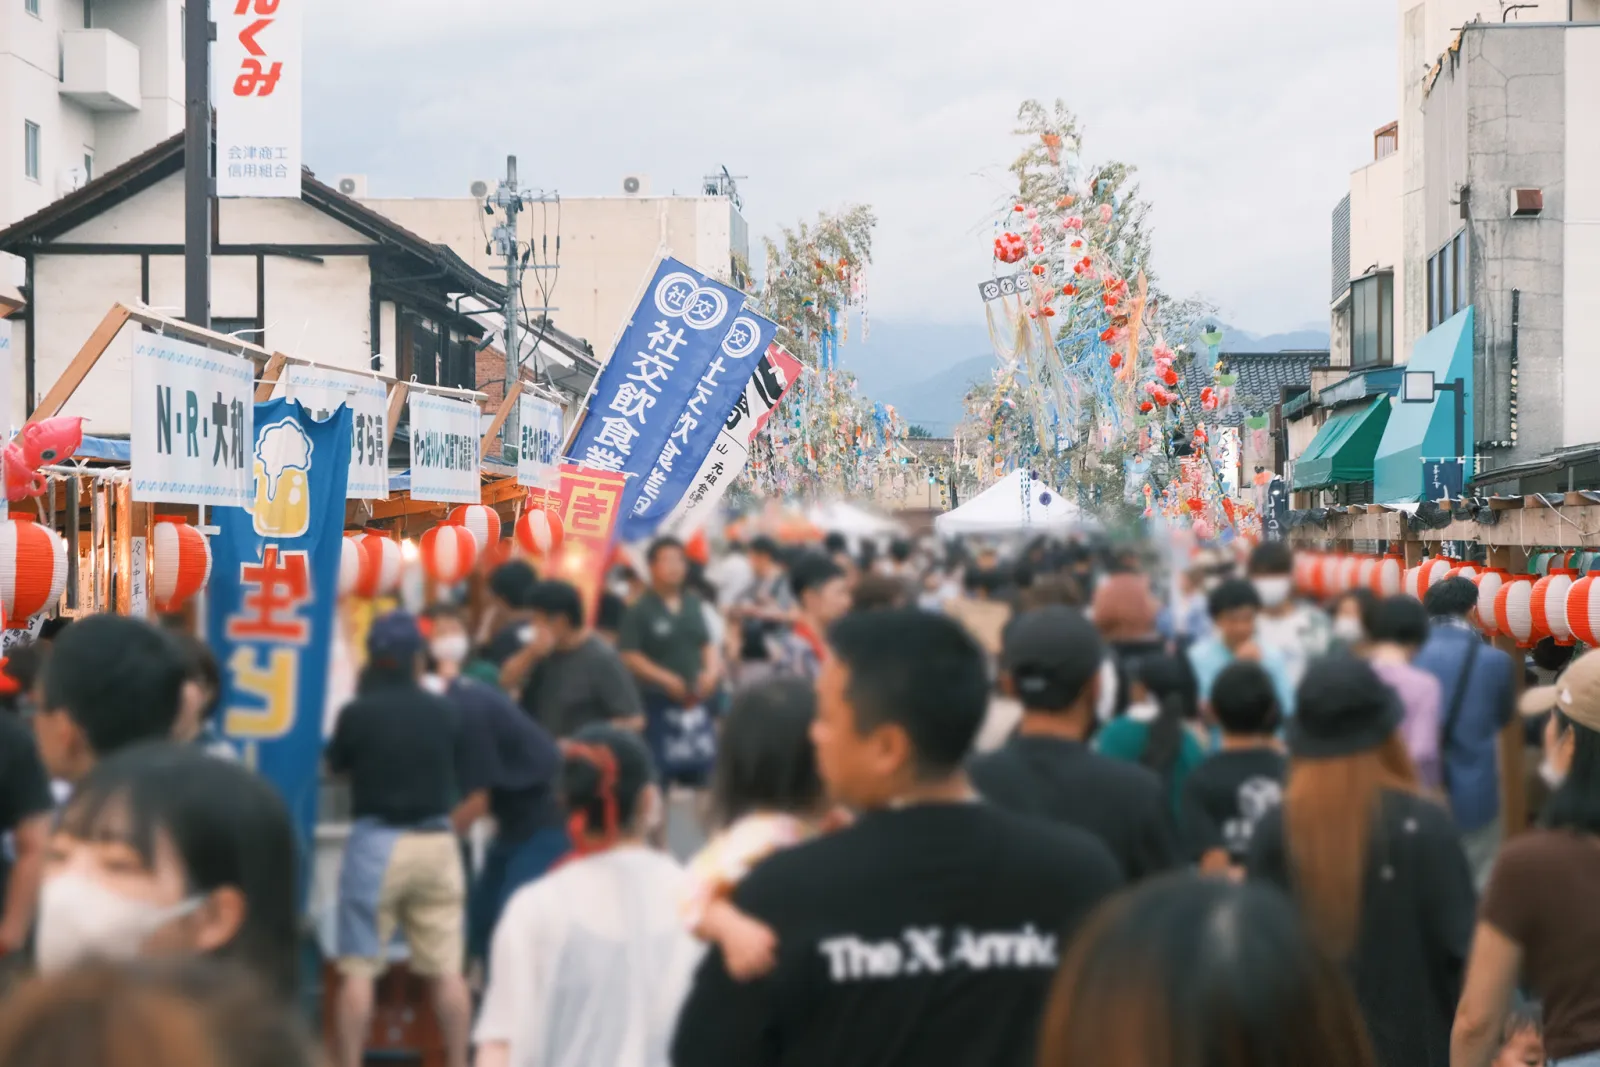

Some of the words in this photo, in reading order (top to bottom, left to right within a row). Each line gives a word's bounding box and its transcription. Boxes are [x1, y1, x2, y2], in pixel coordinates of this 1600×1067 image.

[228, 146, 288, 160] 会津商工
[228, 164, 288, 179] 信用組合
